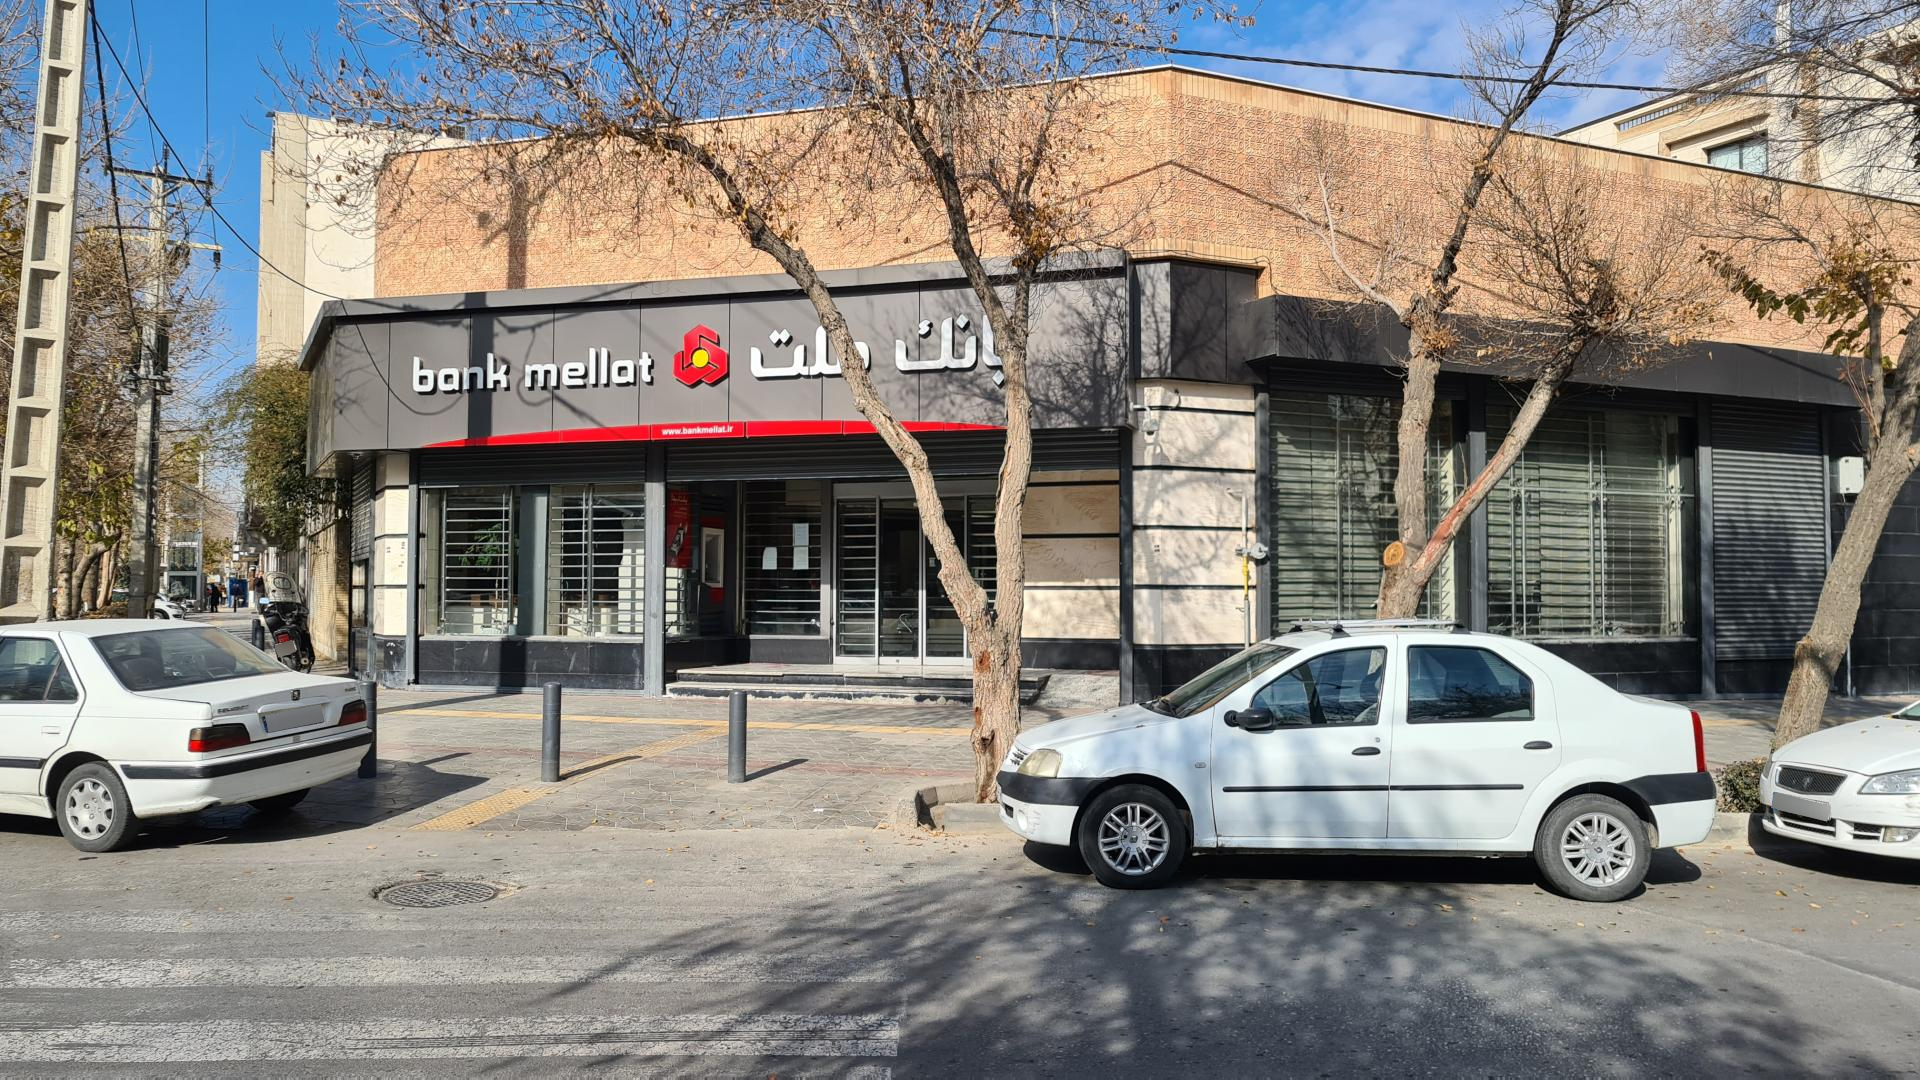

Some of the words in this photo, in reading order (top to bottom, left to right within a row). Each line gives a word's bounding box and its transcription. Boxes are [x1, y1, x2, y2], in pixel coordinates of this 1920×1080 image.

[412, 352, 509, 393] bank
[524, 347, 652, 389] mellat
[661, 424, 734, 436] www.bankmellat.ir
